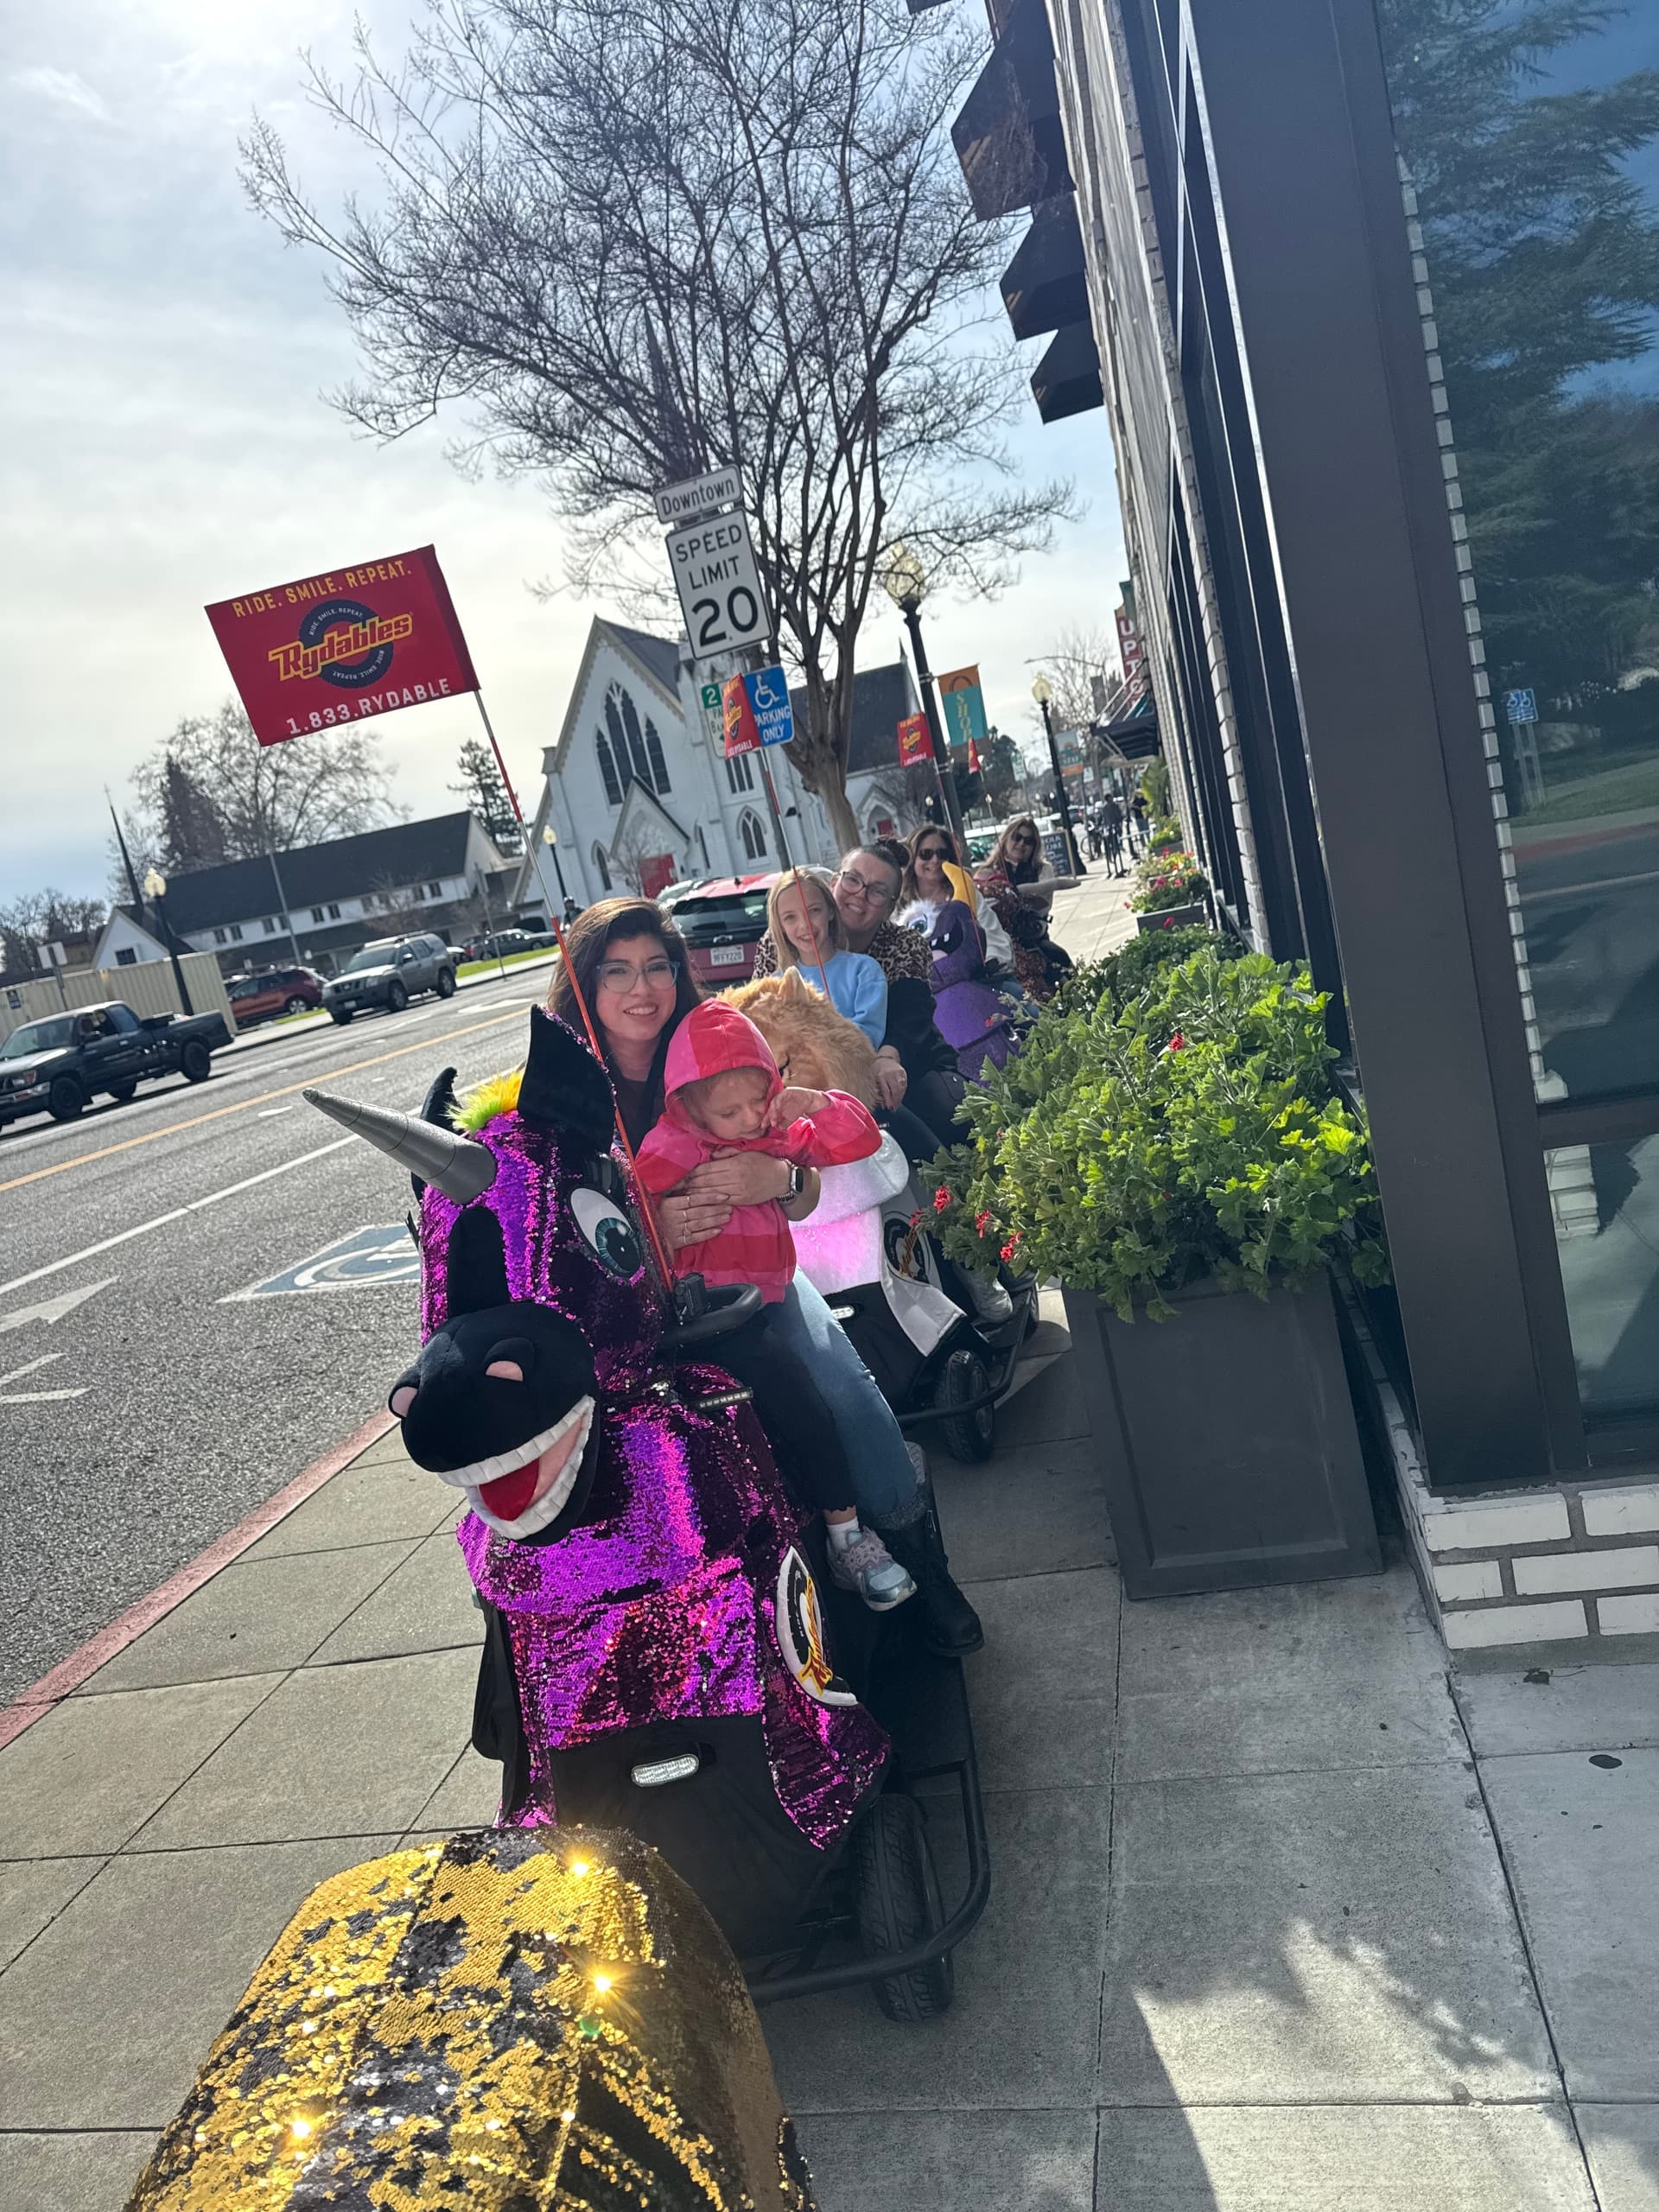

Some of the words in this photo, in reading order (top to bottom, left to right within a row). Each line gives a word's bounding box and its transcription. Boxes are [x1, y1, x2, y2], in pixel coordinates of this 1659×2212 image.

[661, 477, 734, 517] Downtown
[675, 524, 742, 563] SPEED
[232, 593, 283, 618] RIDE.
[285, 576, 343, 603] SMILE.
[346, 559, 411, 588] REPEAT.
[689, 556, 741, 591] LIMIT
[691, 585, 760, 647] 20
[268, 613, 412, 682] Rydables
[286, 677, 452, 734] 1.833.RYDABLE
[706, 687, 719, 705] 2
[957, 691, 972, 742] SHOP
[762, 723, 785, 743] ONLY
